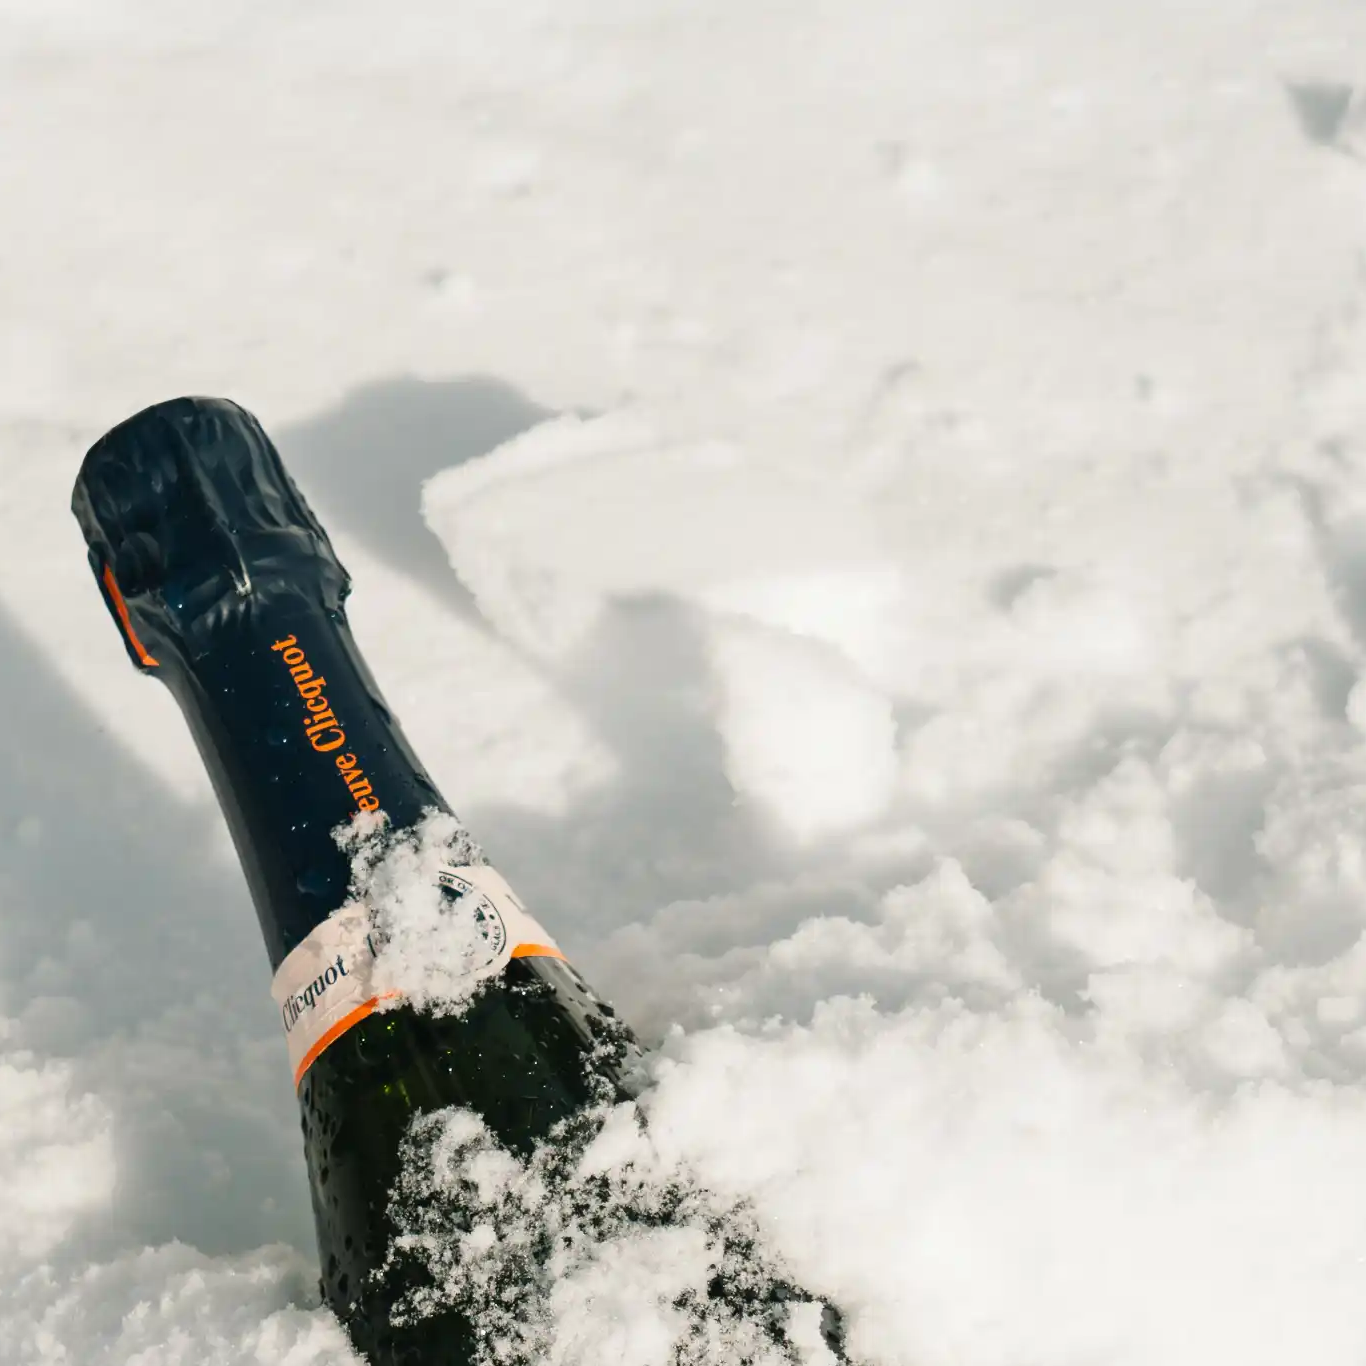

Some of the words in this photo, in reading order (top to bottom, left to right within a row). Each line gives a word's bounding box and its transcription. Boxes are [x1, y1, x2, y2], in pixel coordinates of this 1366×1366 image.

[270, 634, 346, 752] Clicquot
[336, 753, 380, 813] euve
[282, 954, 350, 1033] Clicquot
